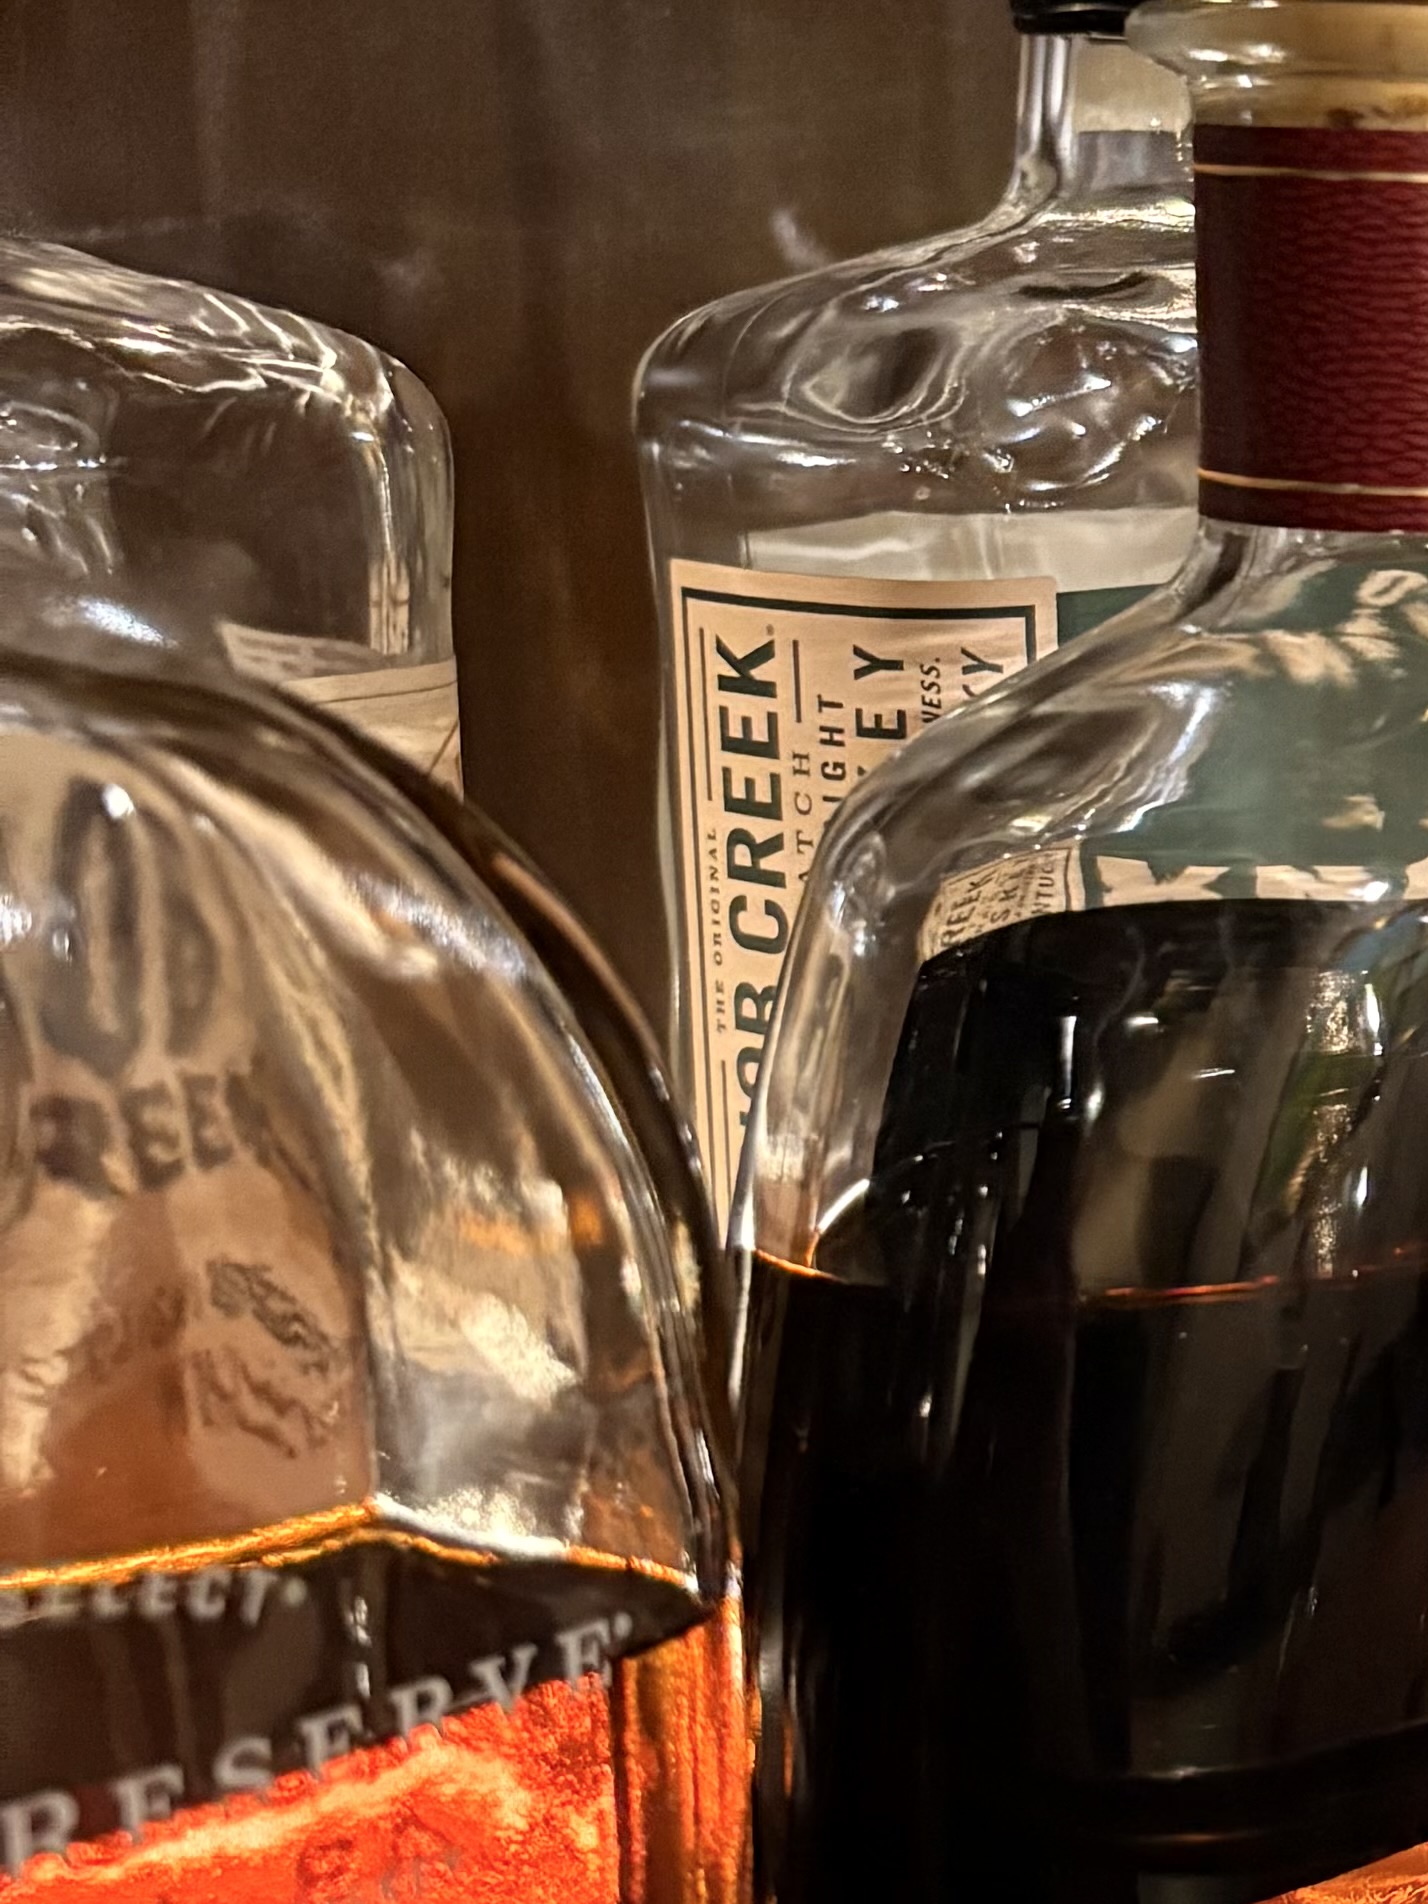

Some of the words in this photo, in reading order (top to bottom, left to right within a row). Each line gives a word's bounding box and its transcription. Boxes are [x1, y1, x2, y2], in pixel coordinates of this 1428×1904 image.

[715, 634, 791, 955] CREEK
[706, 829, 723, 967] ORIGINAL
[713, 980, 728, 1034] THE
